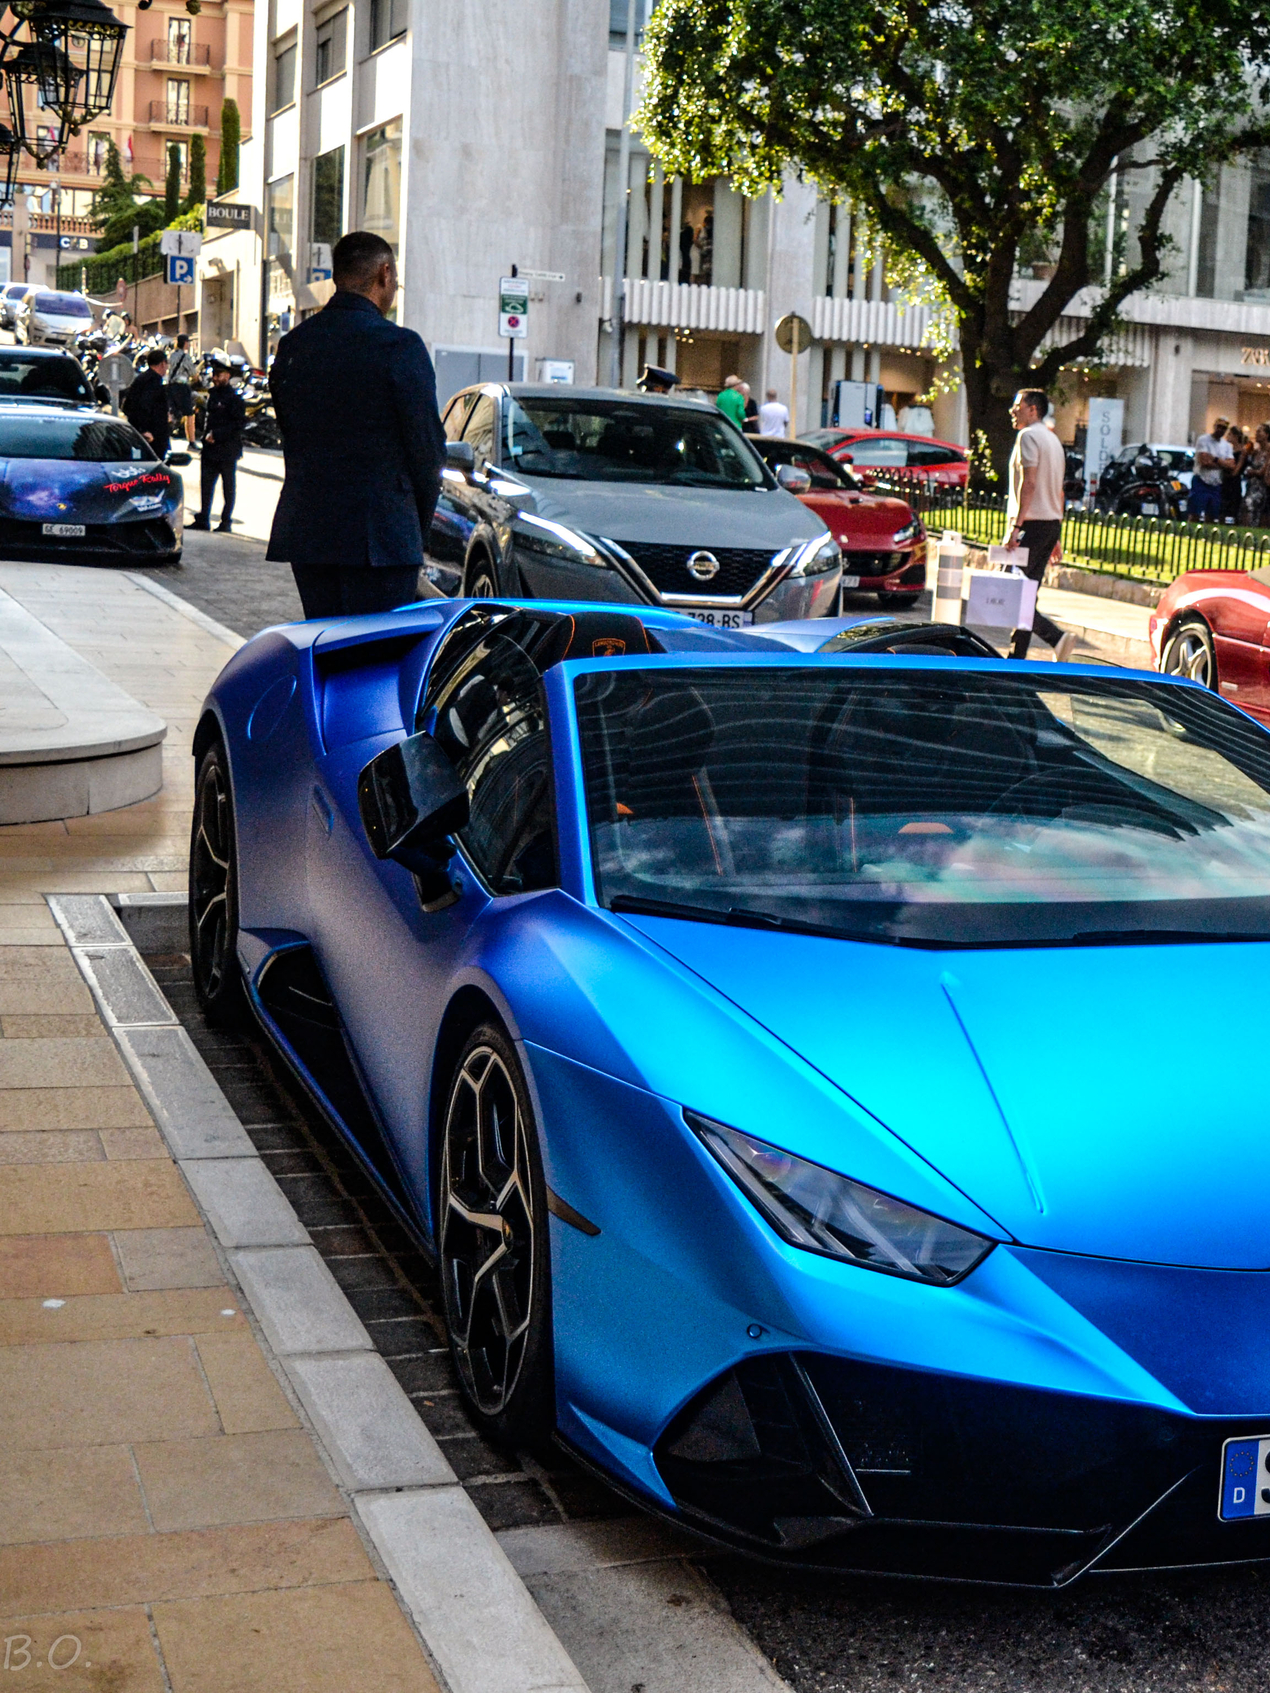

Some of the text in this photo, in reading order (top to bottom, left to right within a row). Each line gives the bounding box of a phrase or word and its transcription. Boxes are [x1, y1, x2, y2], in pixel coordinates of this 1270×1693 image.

[208, 206, 250, 220] BOULE
[175, 260, 188, 279] P
[103, 473, 171, 492] Torque Rally
[1232, 1486, 1246, 1504] D
